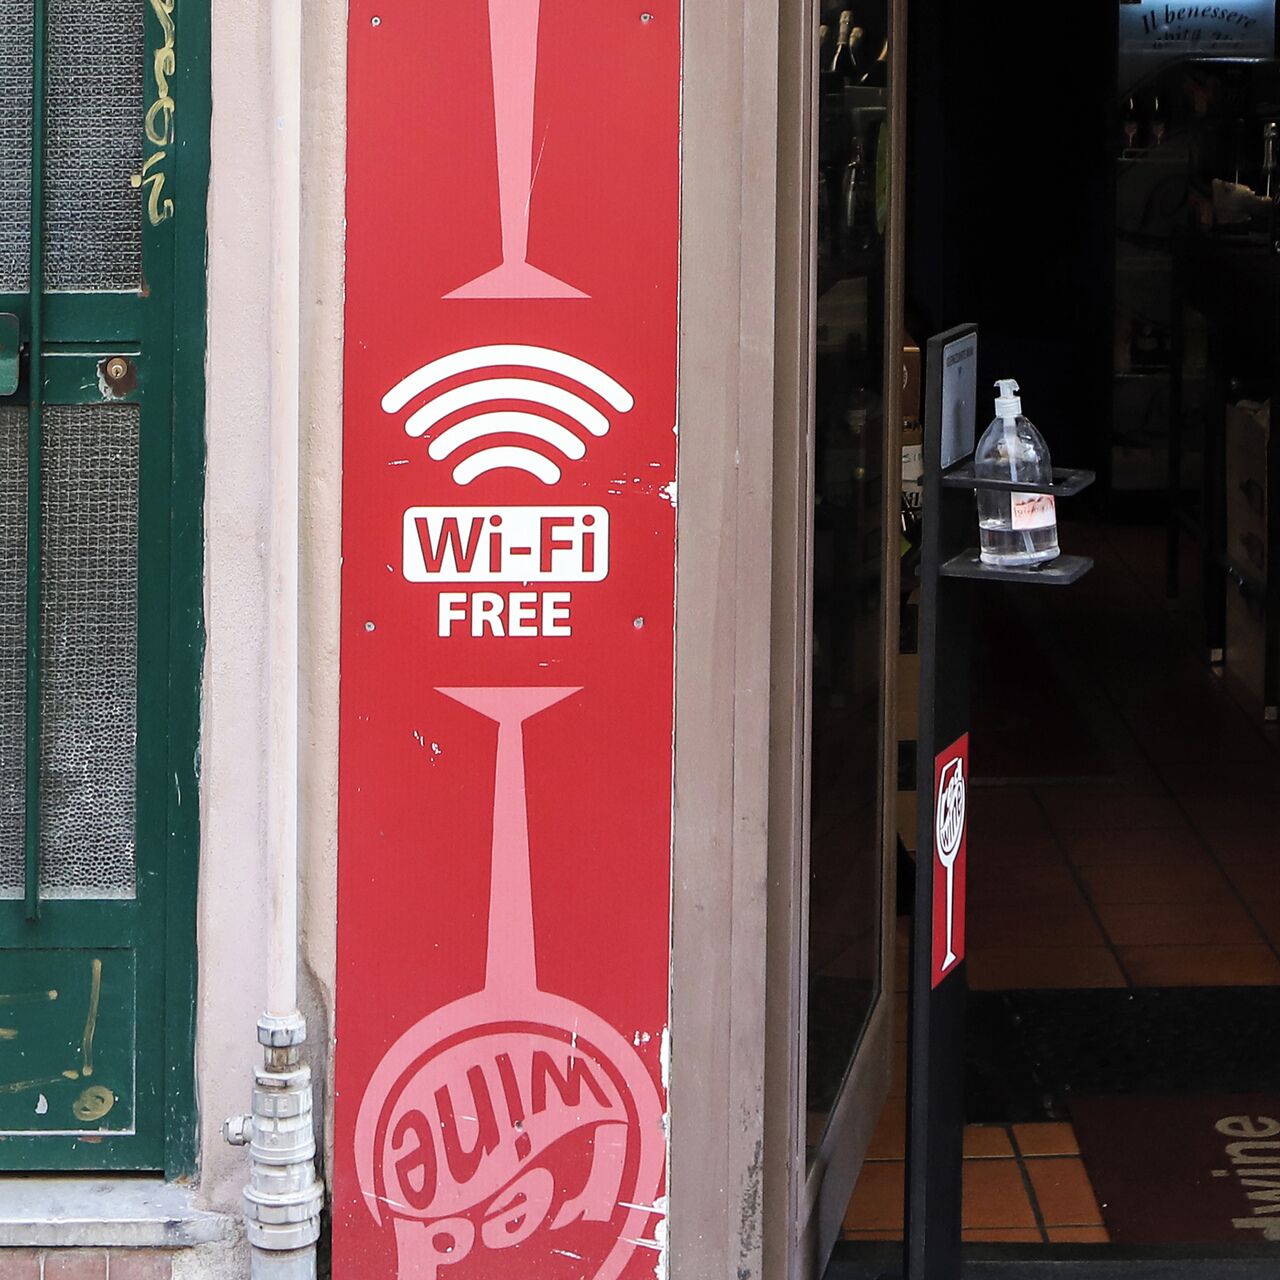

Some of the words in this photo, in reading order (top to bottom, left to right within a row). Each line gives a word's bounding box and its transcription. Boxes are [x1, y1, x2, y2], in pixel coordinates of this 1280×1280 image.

[414, 515, 596, 573] Wi-Fi
[438, 592, 572, 638] FREE
[941, 781, 963, 848] wine
[391, 1051, 614, 1210] wine
[393, 1123, 629, 1280] red
